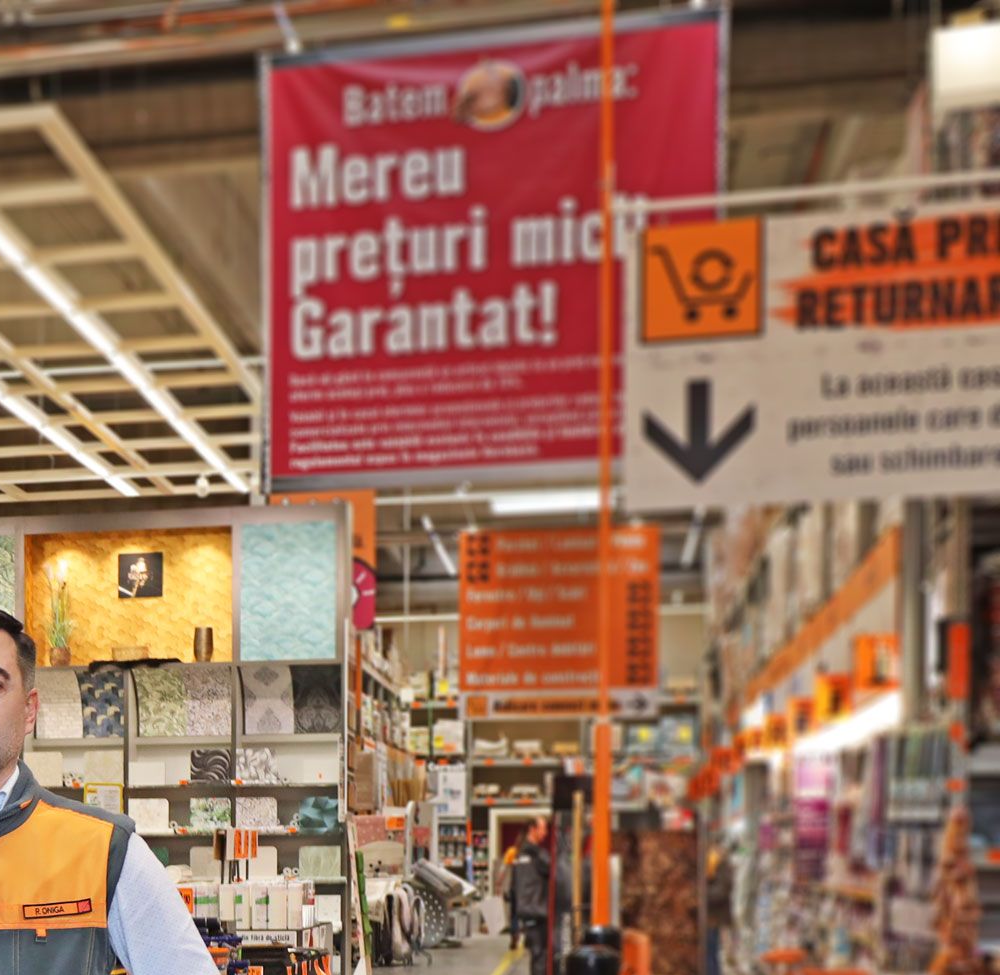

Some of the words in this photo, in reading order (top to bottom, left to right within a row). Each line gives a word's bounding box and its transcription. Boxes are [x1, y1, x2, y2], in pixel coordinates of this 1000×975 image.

[341, 80, 449, 128] Batem
[290, 143, 466, 211] Mereu
[290, 204, 487, 300] prețuri
[811, 205, 917, 273] CASĂ
[935, 212, 1000, 261] PR
[290, 281, 558, 361] Garantat!
